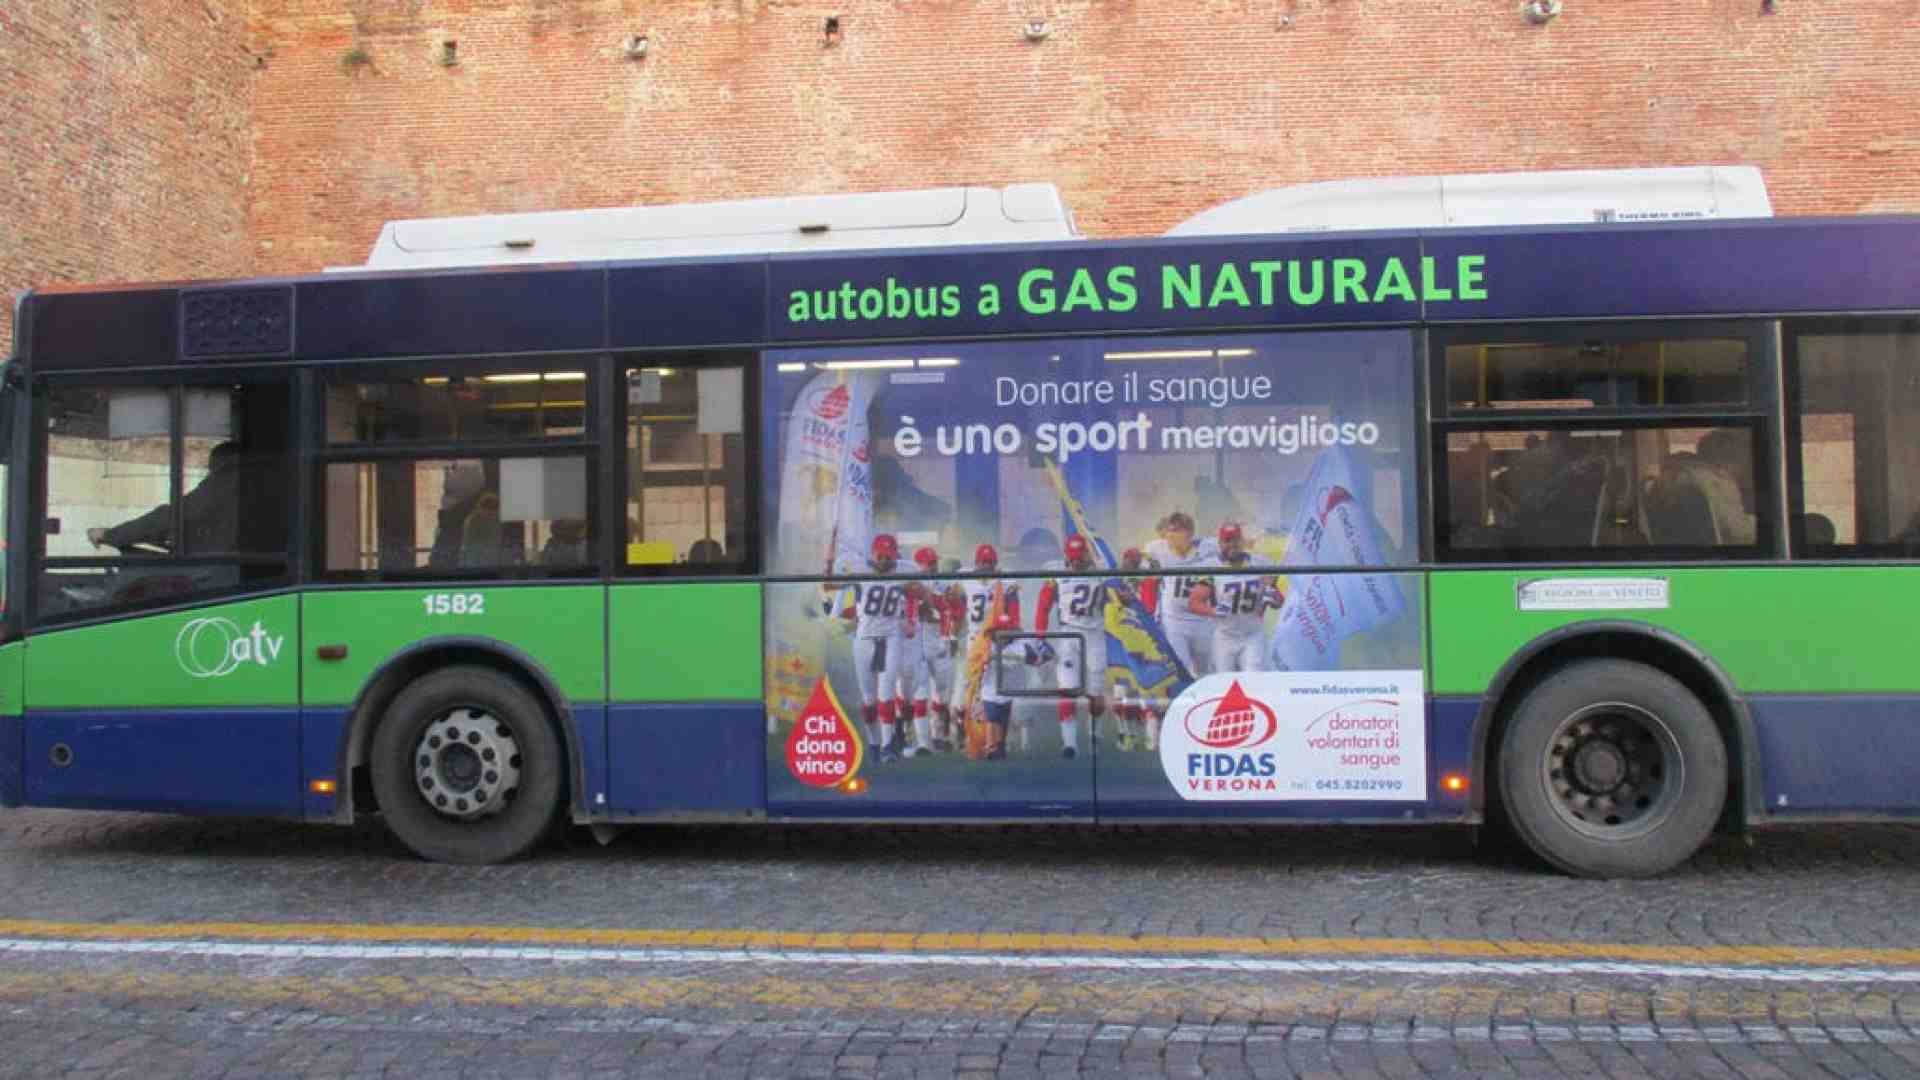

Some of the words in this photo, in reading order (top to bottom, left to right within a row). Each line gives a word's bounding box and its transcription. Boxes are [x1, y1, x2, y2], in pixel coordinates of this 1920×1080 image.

[787, 277, 961, 322] autobus
[976, 282, 1000, 316] a
[1017, 265, 1138, 315] GAS
[1161, 254, 1489, 310] NATURALE
[995, 376, 1114, 407] Donare
[1123, 371, 1138, 403] il
[1149, 375, 1272, 408] sangue
[893, 415, 923, 457] è
[936, 422, 1022, 456] uno
[1034, 411, 1153, 463] sport
[1161, 415, 1380, 455] meraviglioso
[421, 592, 485, 615] 1582
[864, 585, 903, 617] 88
[1224, 579, 1260, 615] 75
[231, 620, 285, 666] atv
[1289, 684, 1400, 697] www.fidasverona.it
[804, 715, 837, 735] Chi
[1328, 711, 1400, 731] donatori
[795, 735, 847, 755] dona
[1306, 731, 1380, 750] volontari
[1384, 731, 1400, 749] di
[794, 757, 848, 776] vince
[1186, 751, 1277, 778] FIDAS
[1340, 753, 1401, 770] sangue
[1187, 777, 1278, 792] VERONA
